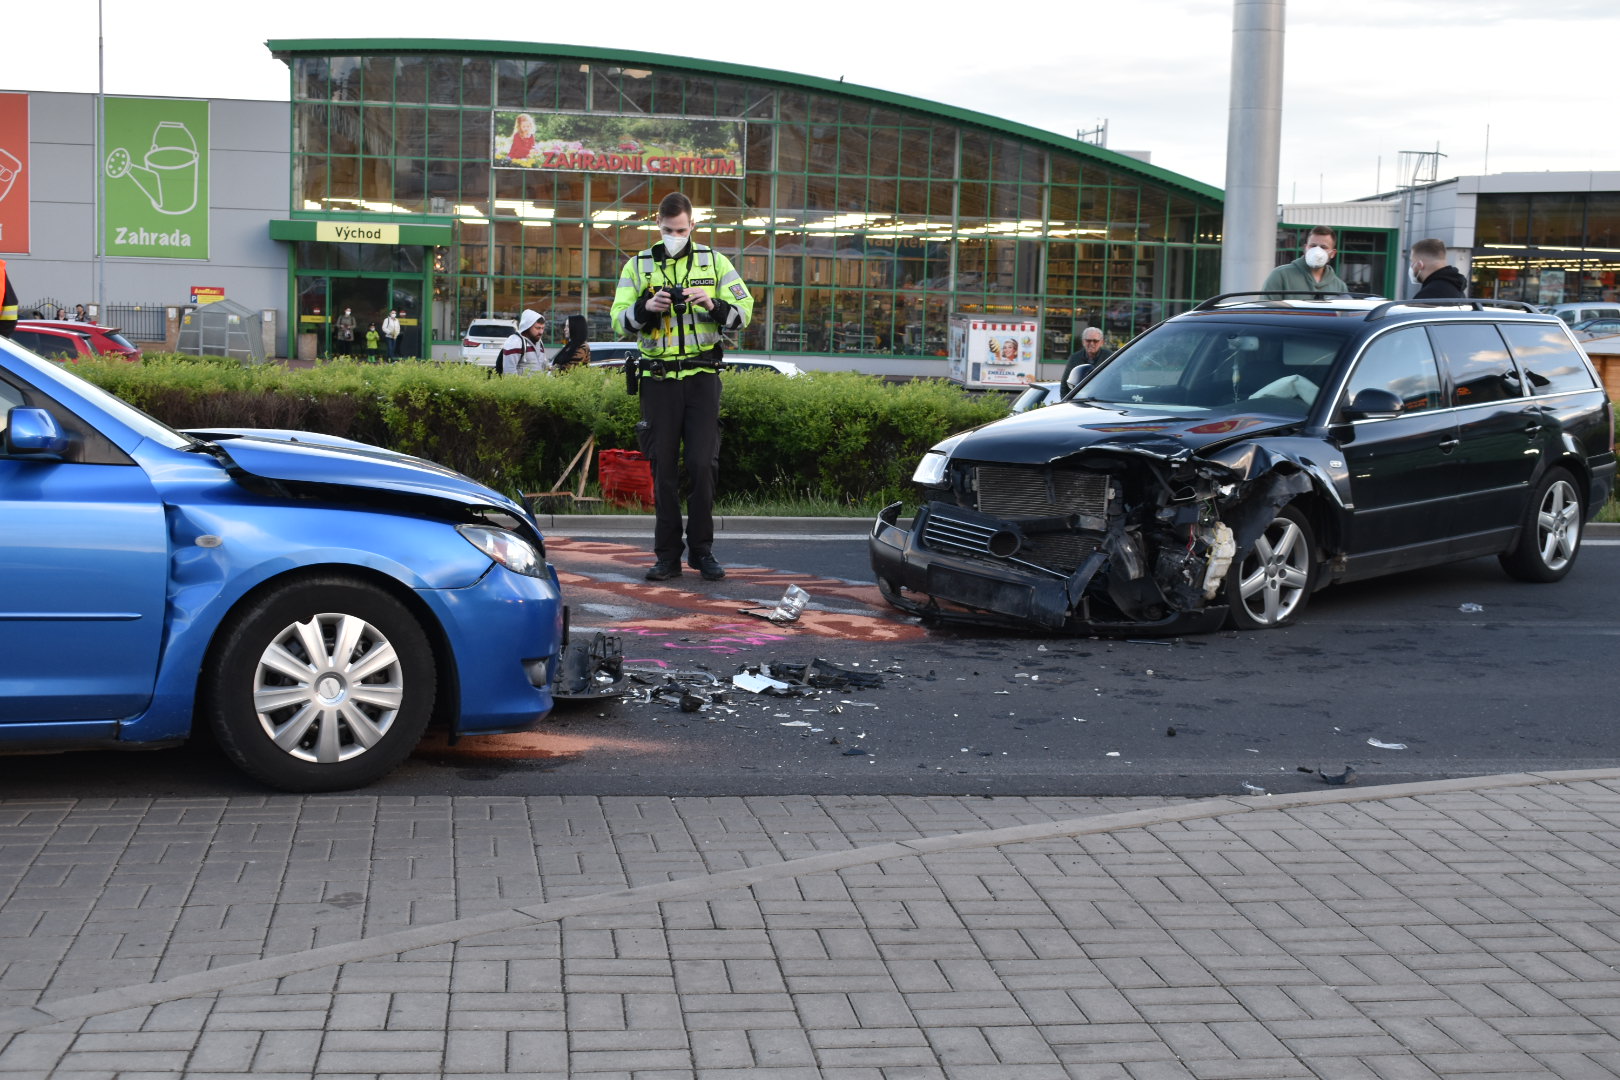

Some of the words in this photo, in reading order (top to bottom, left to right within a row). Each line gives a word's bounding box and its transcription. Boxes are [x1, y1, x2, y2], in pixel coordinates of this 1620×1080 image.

[542, 150, 643, 171] ZAHRADNÍ
[646, 156, 736, 175] CENTRUM
[114, 227, 192, 247] Zahrada
[335, 226, 381, 240] Východ
